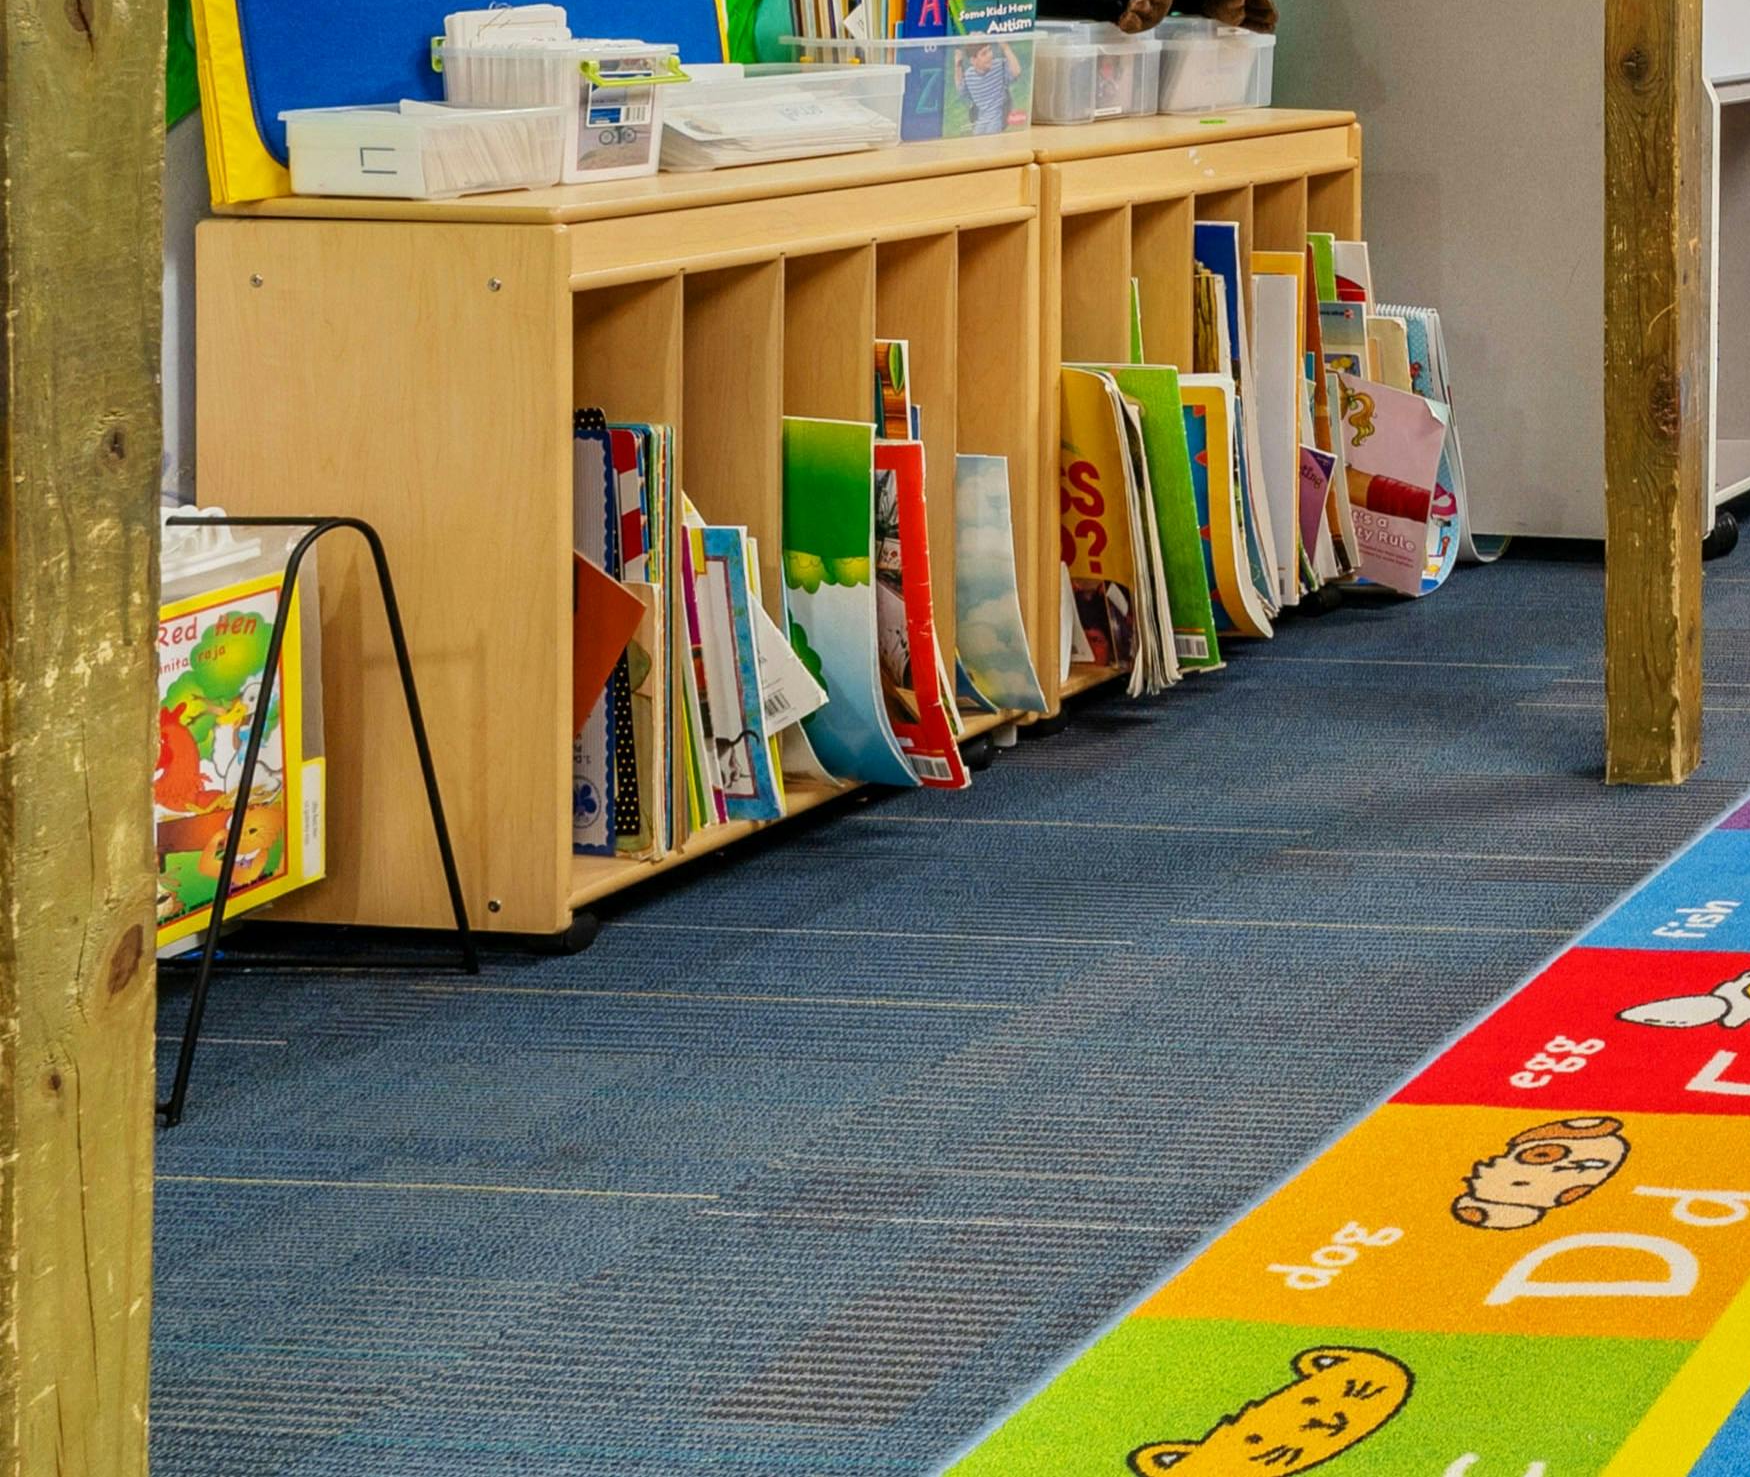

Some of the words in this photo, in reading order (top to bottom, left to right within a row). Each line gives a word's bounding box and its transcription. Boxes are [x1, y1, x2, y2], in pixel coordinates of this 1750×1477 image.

[958, 8, 985, 22] Some
[986, 3, 1007, 18] Kids
[1008, 2, 1033, 14] Have
[986, 17, 1032, 34] Autism
[915, 67, 943, 114] Z
[1352, 510, 1372, 525] t's
[1377, 516, 1388, 528] a
[1377, 530, 1416, 551] Rule
[158, 616, 198, 647] Red
[214, 613, 258, 637] Hen
[197, 644, 227, 663] roja
[1652, 900, 1739, 938] fish
[1511, 1036, 1604, 1088] egg
[1273, 1223, 1401, 1288] dog
